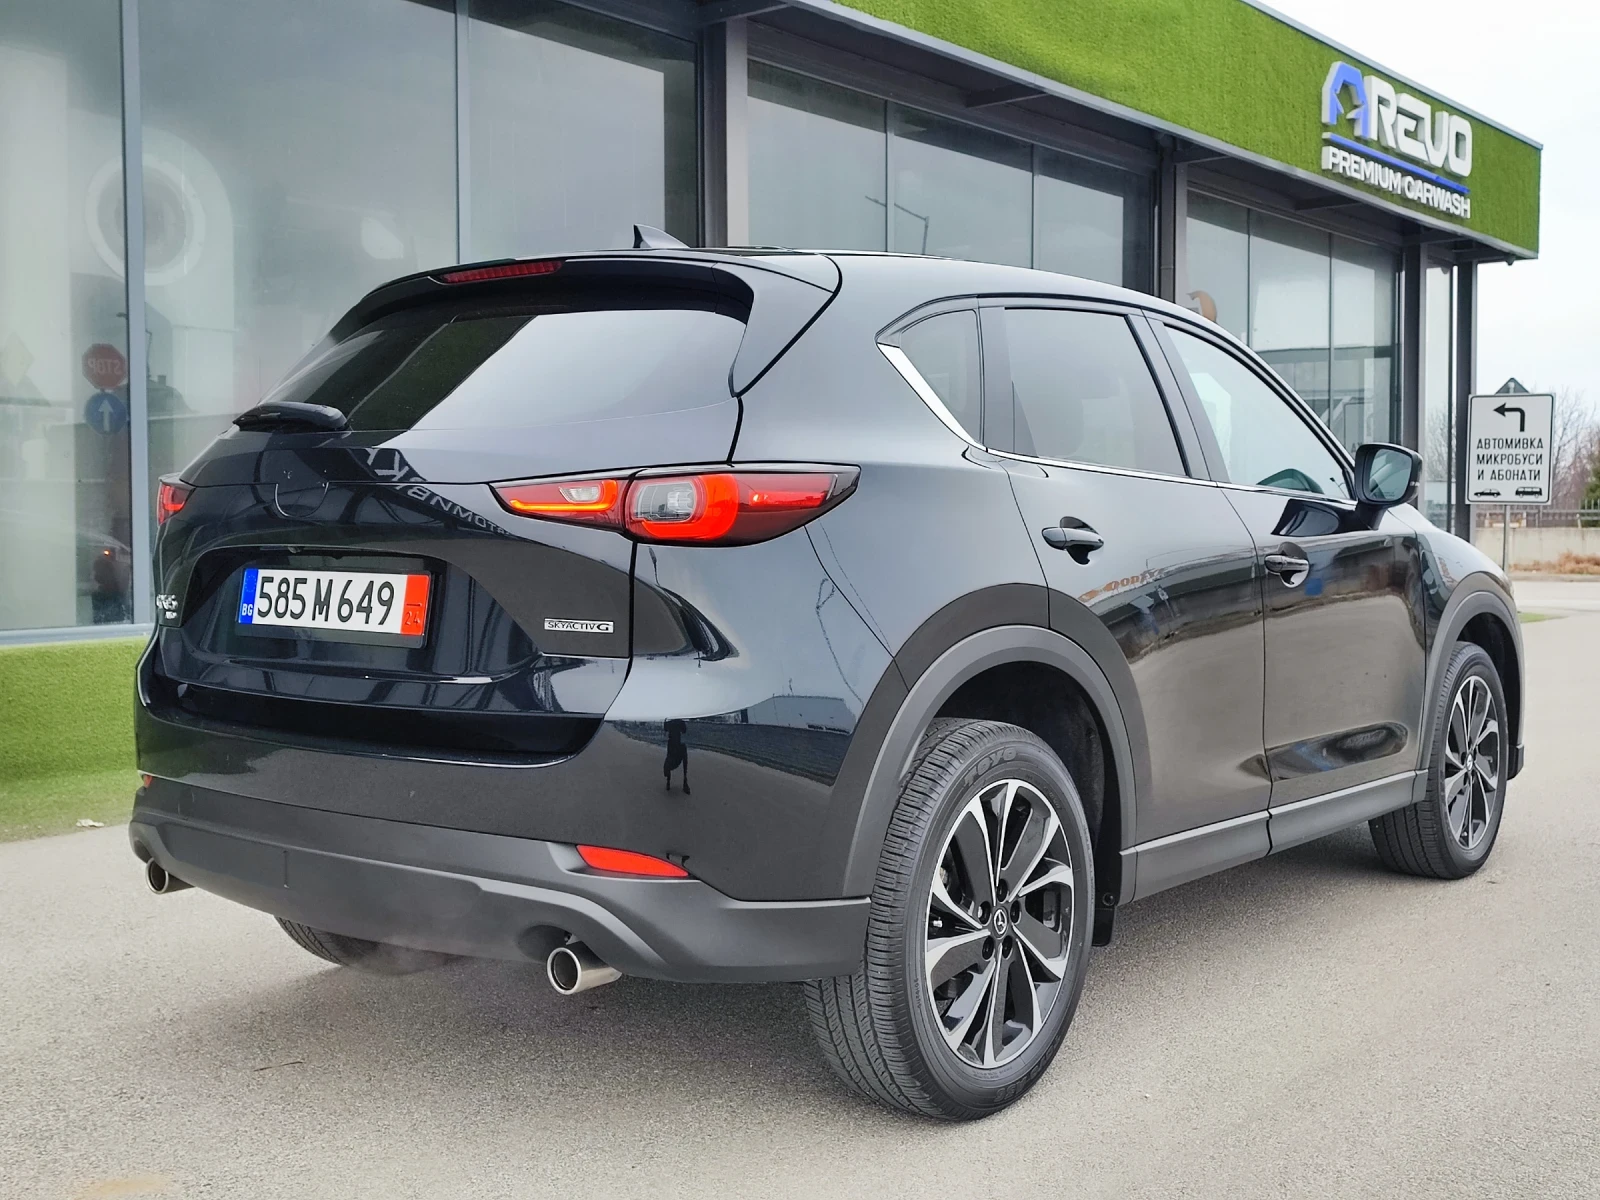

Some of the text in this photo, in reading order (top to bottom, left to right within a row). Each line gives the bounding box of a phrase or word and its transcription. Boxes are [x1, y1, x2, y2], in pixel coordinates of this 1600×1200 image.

[1322, 145, 1471, 219] PREMIUM CARWASH
[1476, 437, 1544, 450] АВТОМИВКА
[1476, 453, 1543, 465] МИКРОБУСИ
[1477, 469, 1541, 481] И АБОНАТИ
[241, 602, 254, 616] BG
[404, 611, 421, 628] 24
[963, 746, 1017, 787] TOYO
